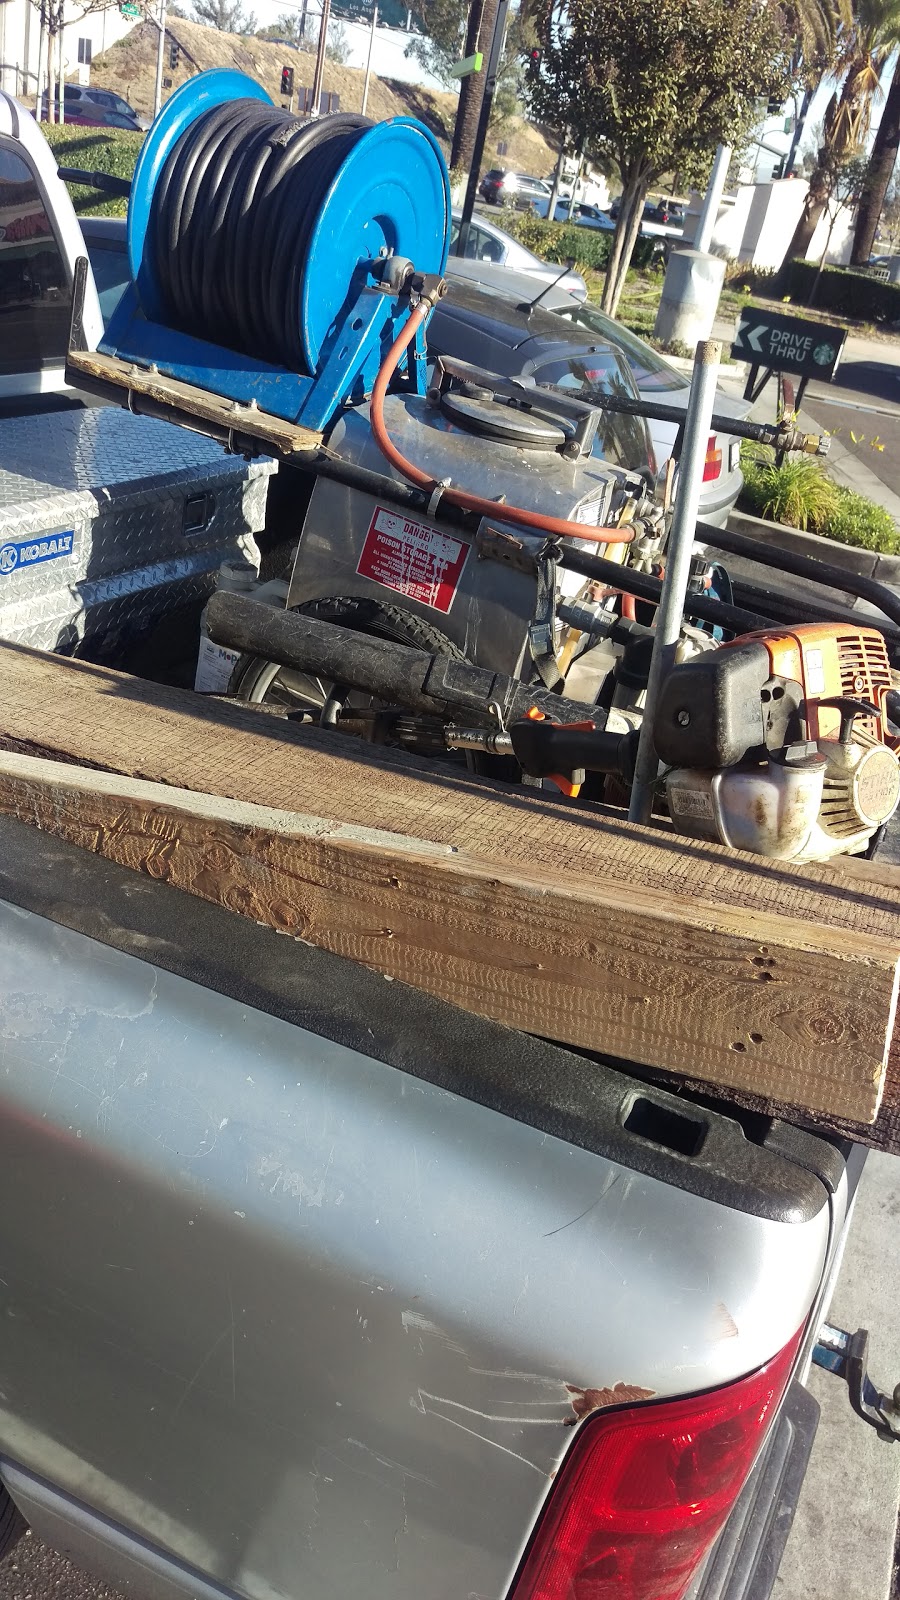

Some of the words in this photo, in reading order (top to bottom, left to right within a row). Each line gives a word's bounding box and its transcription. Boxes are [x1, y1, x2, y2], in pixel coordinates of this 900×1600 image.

[361, 6, 383, 15] Angees
[771, 330, 813, 350] DRIVE
[769, 343, 806, 361] THRU
[20, 536, 72, 562] KOBALT
[377, 534, 400, 550] POISON
